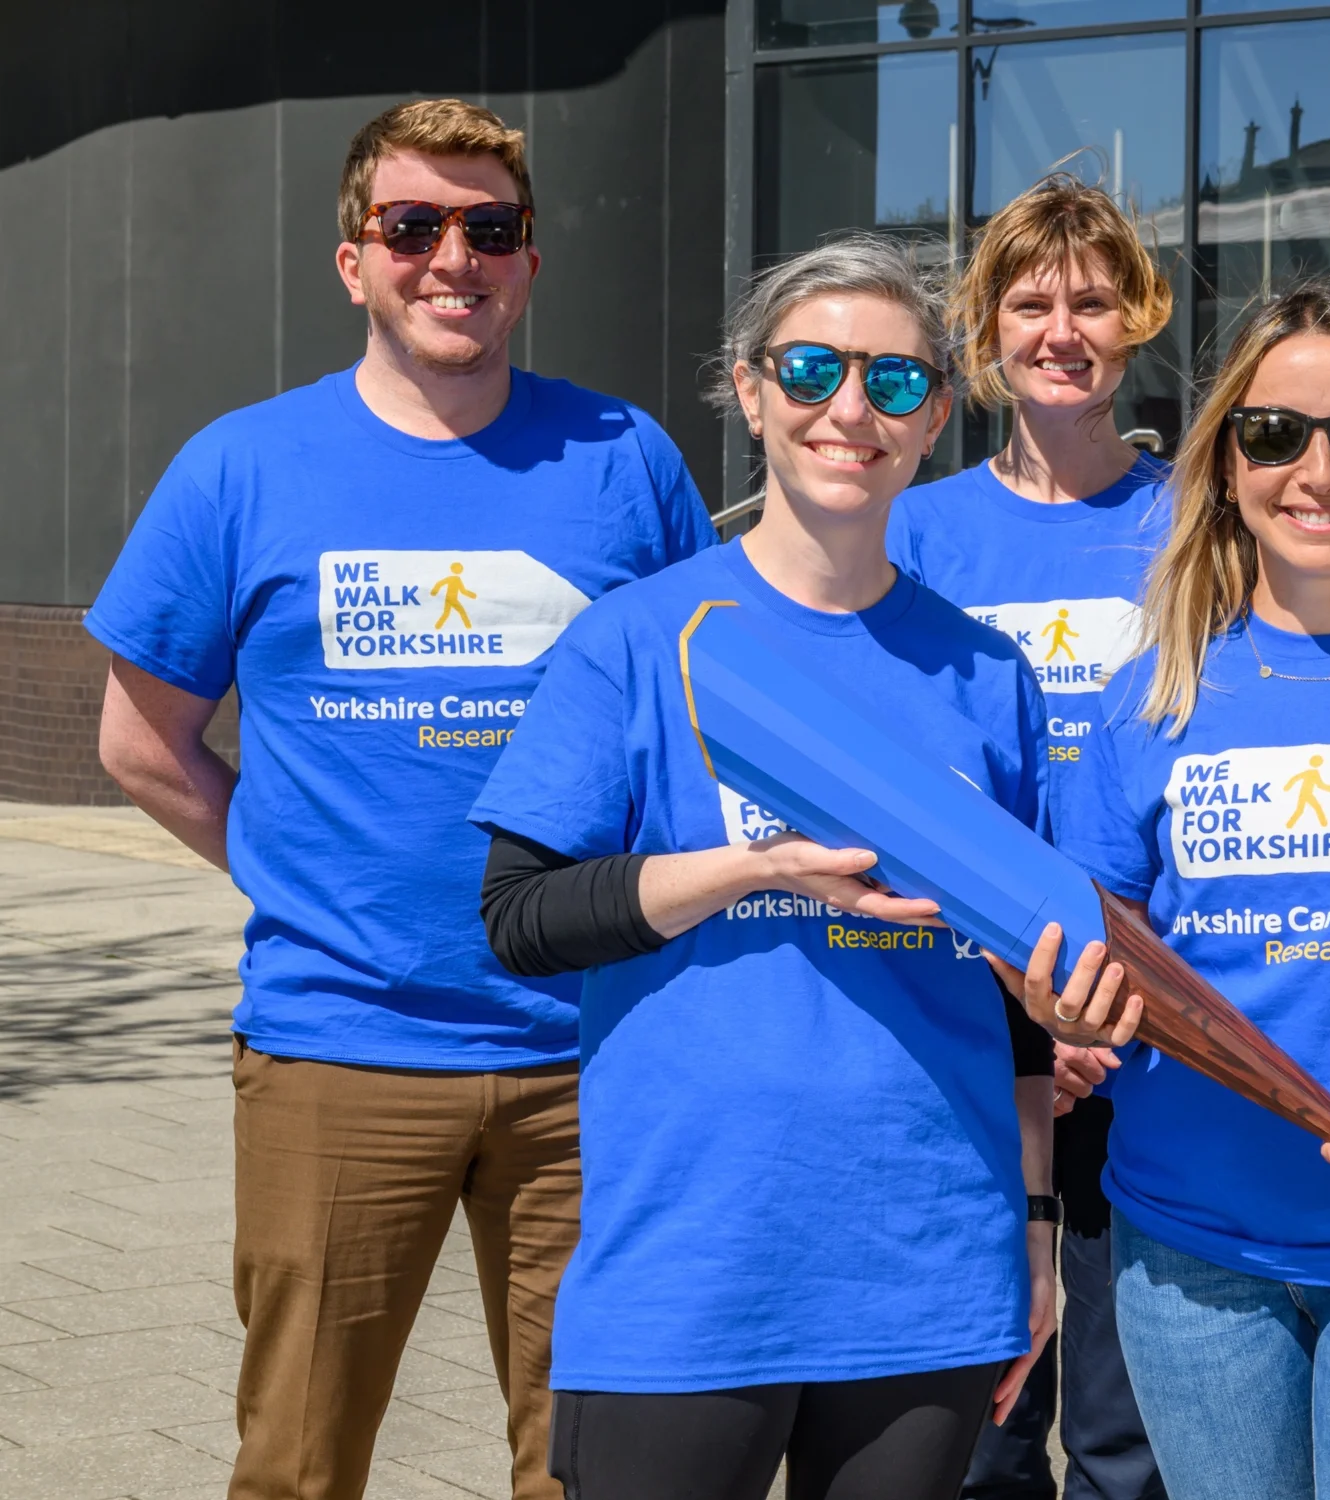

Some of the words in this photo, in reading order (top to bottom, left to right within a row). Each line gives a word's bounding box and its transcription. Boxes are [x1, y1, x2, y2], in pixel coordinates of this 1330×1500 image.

[334, 561, 380, 584] WE
[334, 585, 421, 609] WALK
[335, 610, 396, 633] FOR
[335, 633, 503, 657] YORKSHIRE
[1036, 663, 1103, 684] SHIRE
[310, 696, 434, 719] Yorkshire
[440, 695, 531, 719] Cance
[1048, 717, 1092, 737] Can
[1185, 760, 1231, 783] WE
[1180, 782, 1272, 807] WALK
[740, 801, 779, 825] FO
[1182, 808, 1242, 836] FOR
[827, 924, 934, 949] Research
